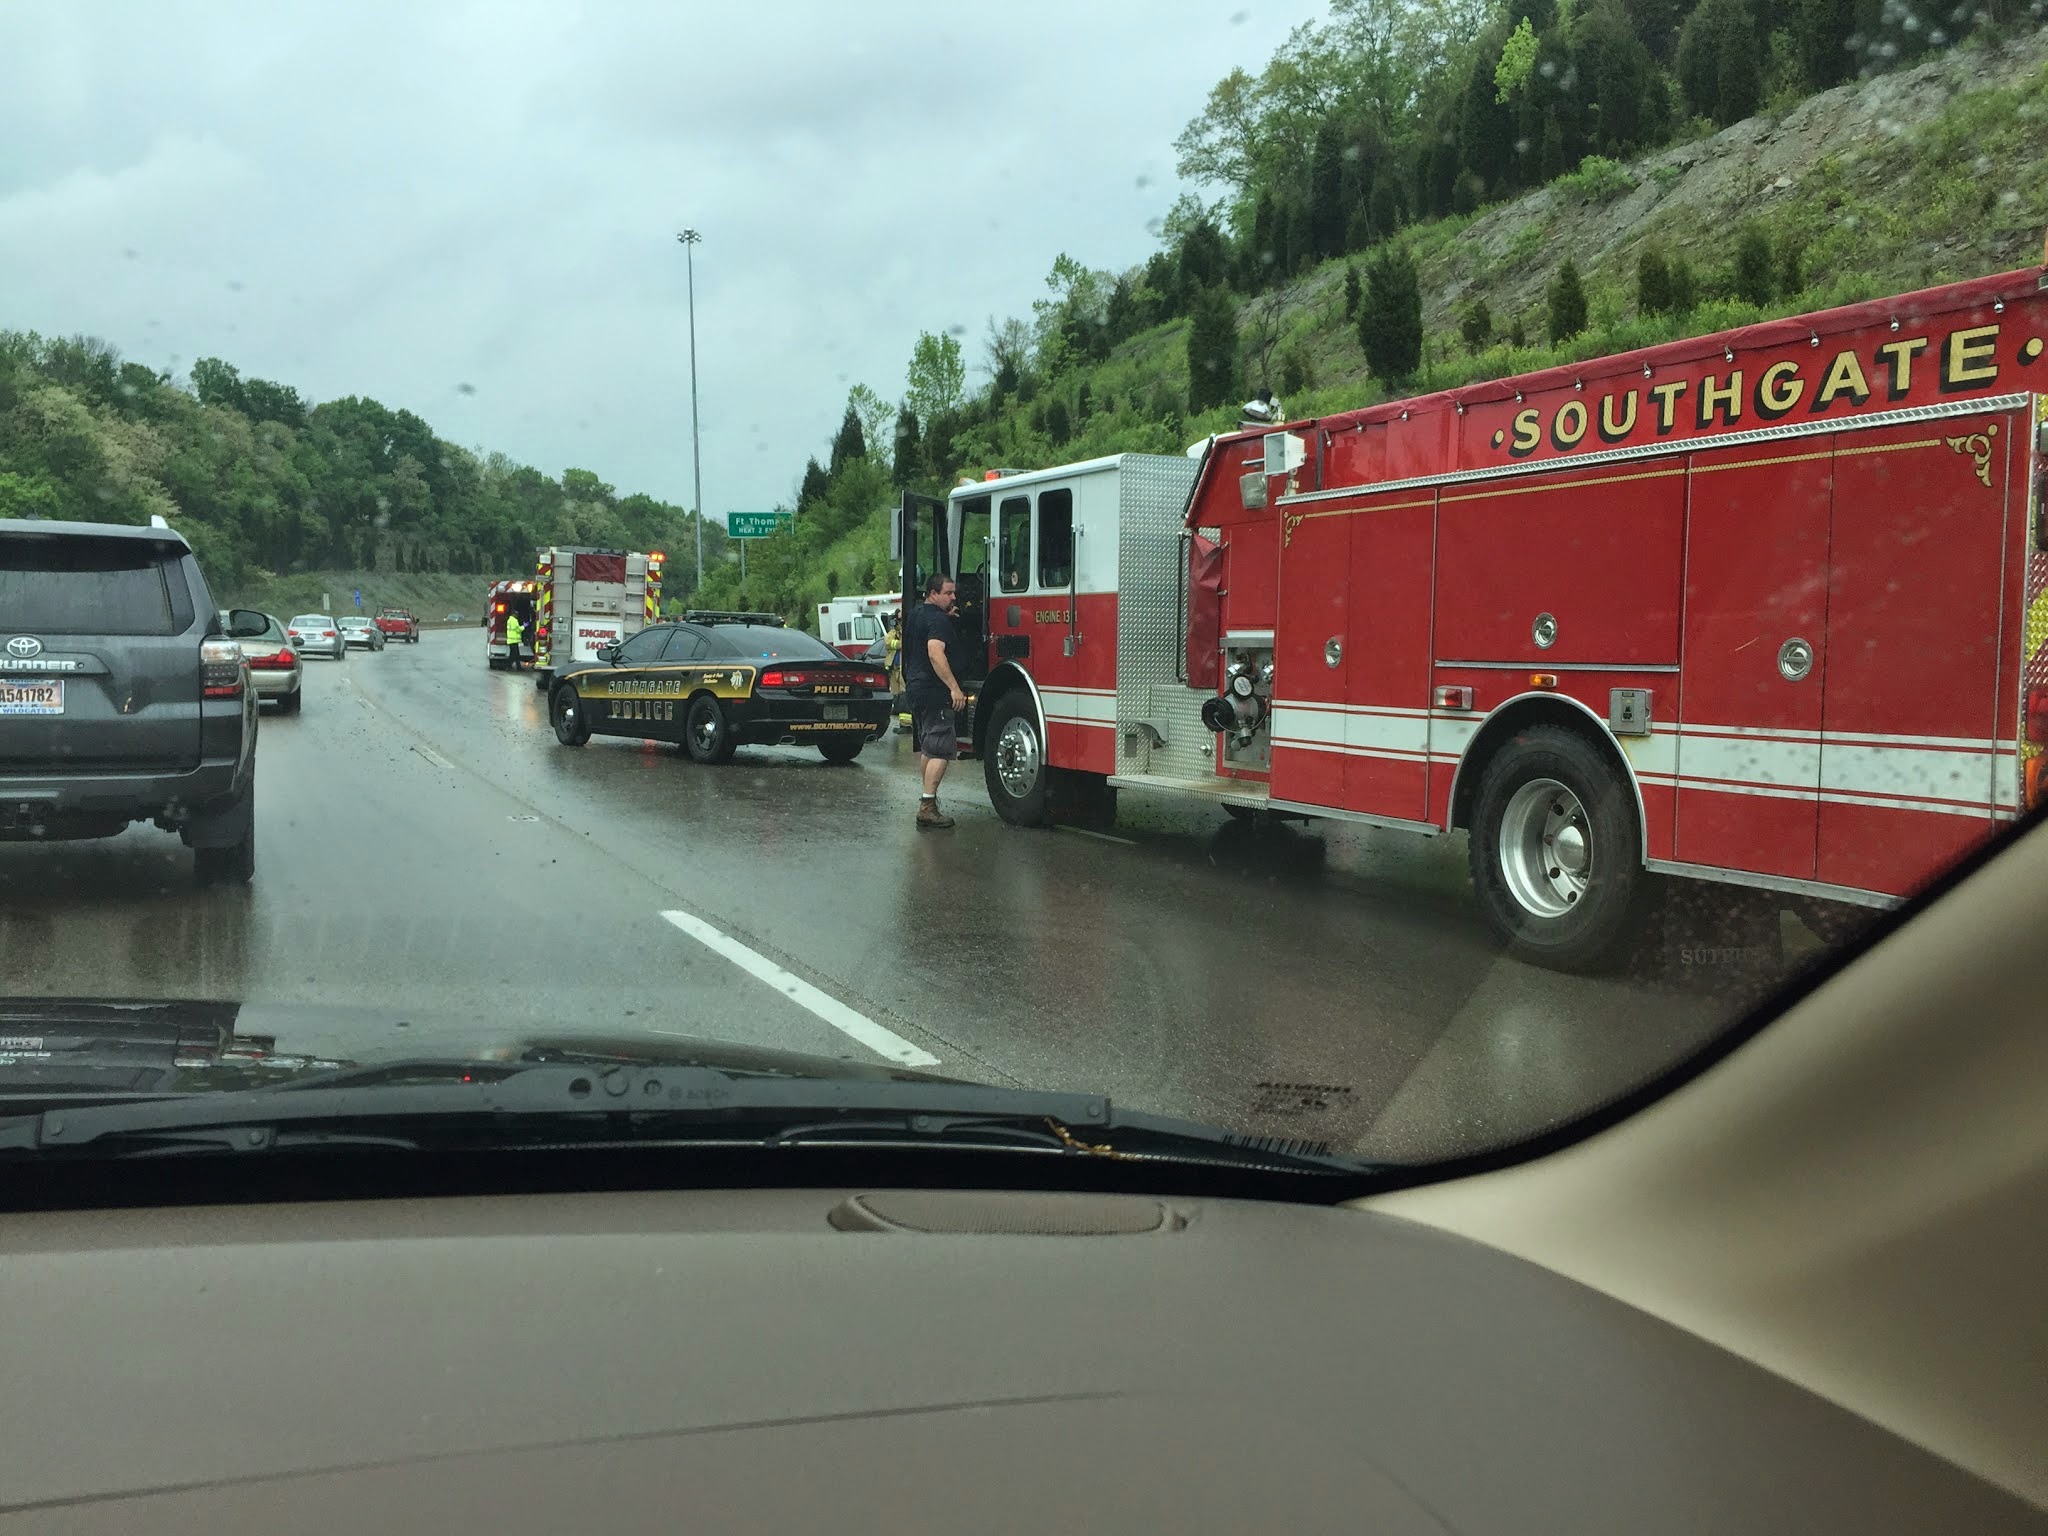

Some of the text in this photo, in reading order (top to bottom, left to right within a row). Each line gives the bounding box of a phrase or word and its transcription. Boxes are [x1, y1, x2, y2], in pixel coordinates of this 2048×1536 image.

[1509, 324, 2001, 457] SOUTHGATE
[735, 517, 783, 525] Ft Thom
[1035, 610, 1078, 623] ENGINE 131
[578, 629, 617, 638] ENGINE
[0, 660, 76, 670] UNNER
[608, 680, 681, 694] SOUTHGATE
[814, 685, 850, 694] POLICE
[611, 701, 674, 720] POLICE
